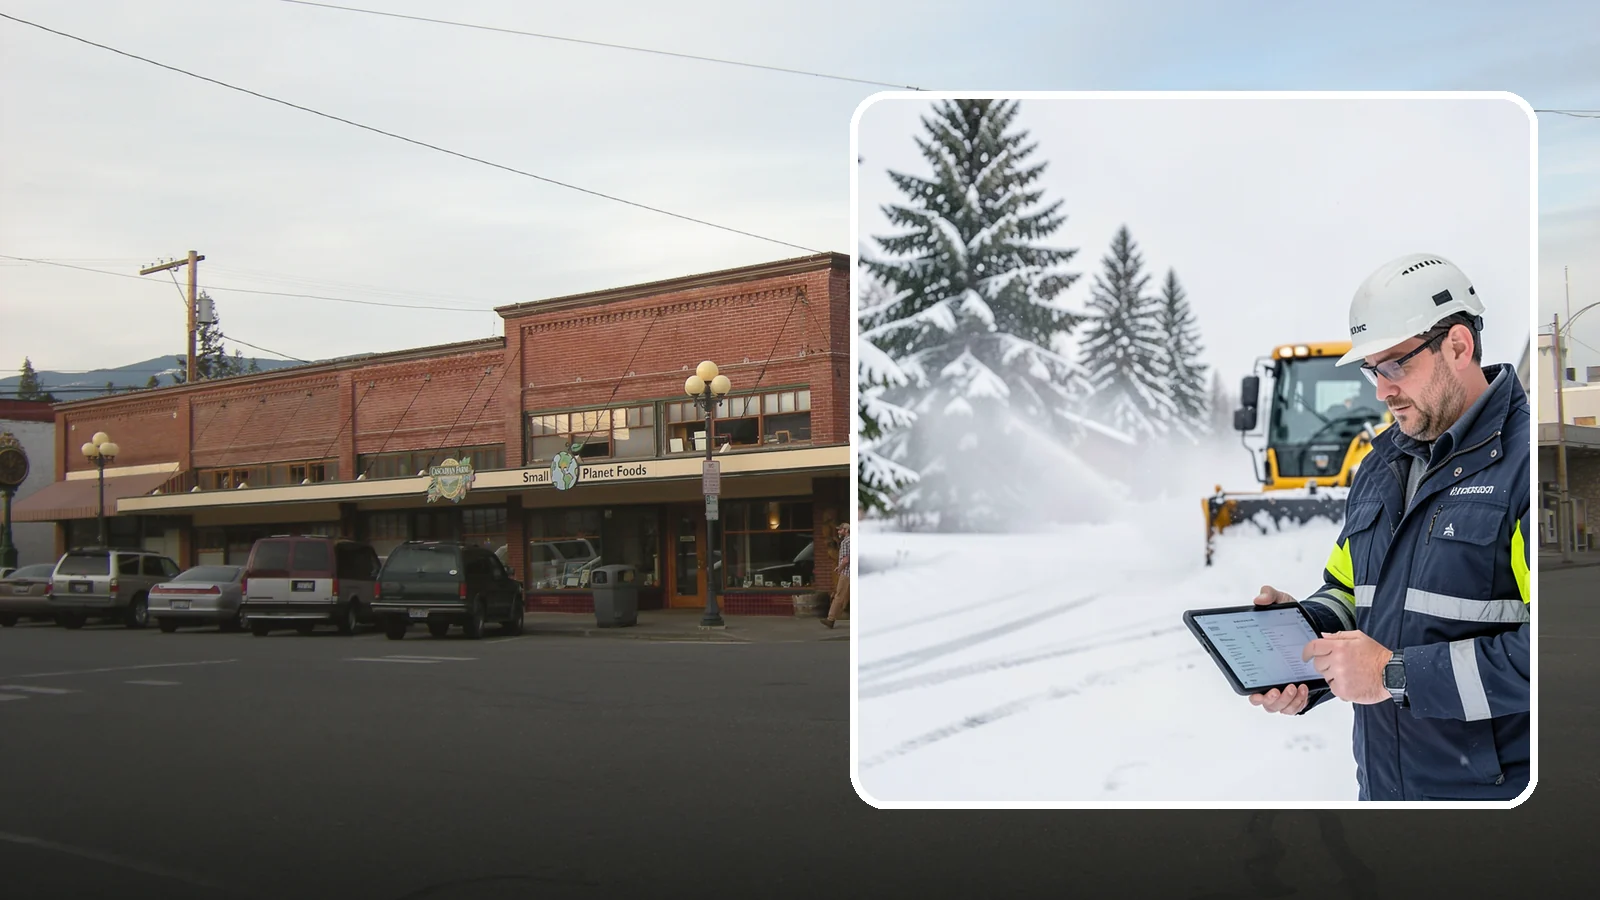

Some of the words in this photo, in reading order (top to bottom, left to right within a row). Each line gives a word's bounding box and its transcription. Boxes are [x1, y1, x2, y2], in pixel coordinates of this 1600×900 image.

[523, 471, 549, 483] Small
[583, 467, 614, 479] Planet
[616, 464, 647, 477] Foods
